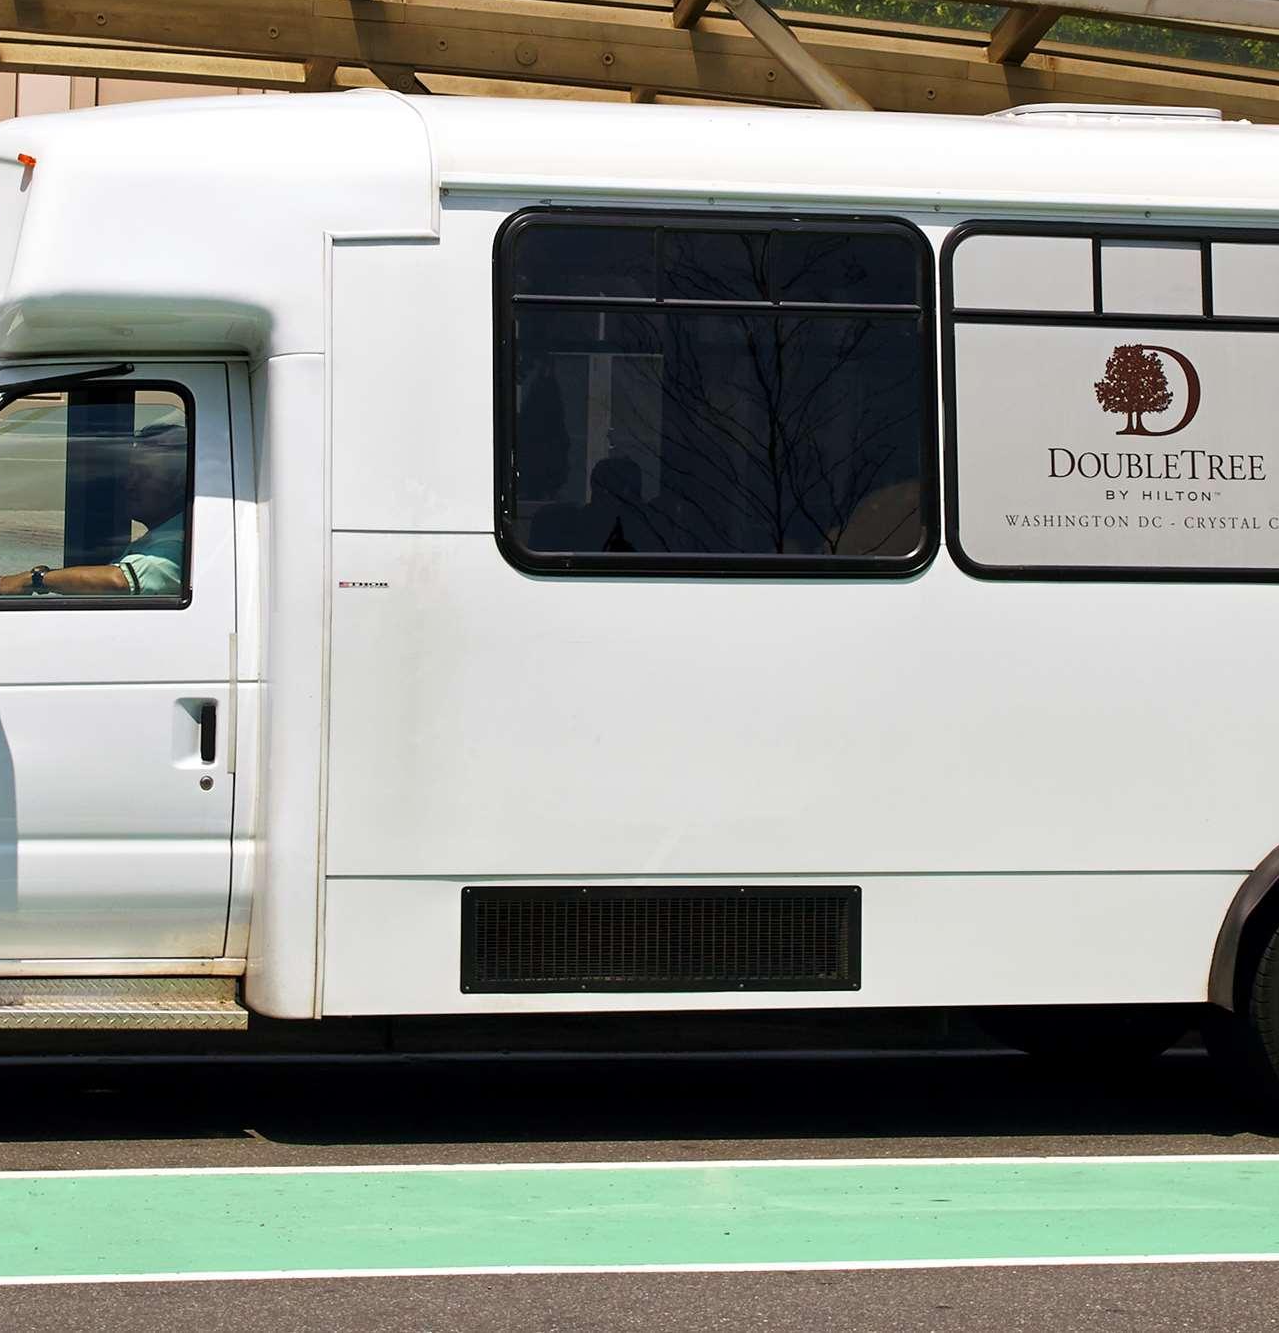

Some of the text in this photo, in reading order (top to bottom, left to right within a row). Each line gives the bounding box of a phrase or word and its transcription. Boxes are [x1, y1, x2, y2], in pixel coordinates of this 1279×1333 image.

[1106, 490, 1129, 501] BY
[1005, 514, 1129, 529] WASHINGTON
[1139, 515, 1162, 529] DC
[1184, 516, 1261, 530] CRYSTAL
